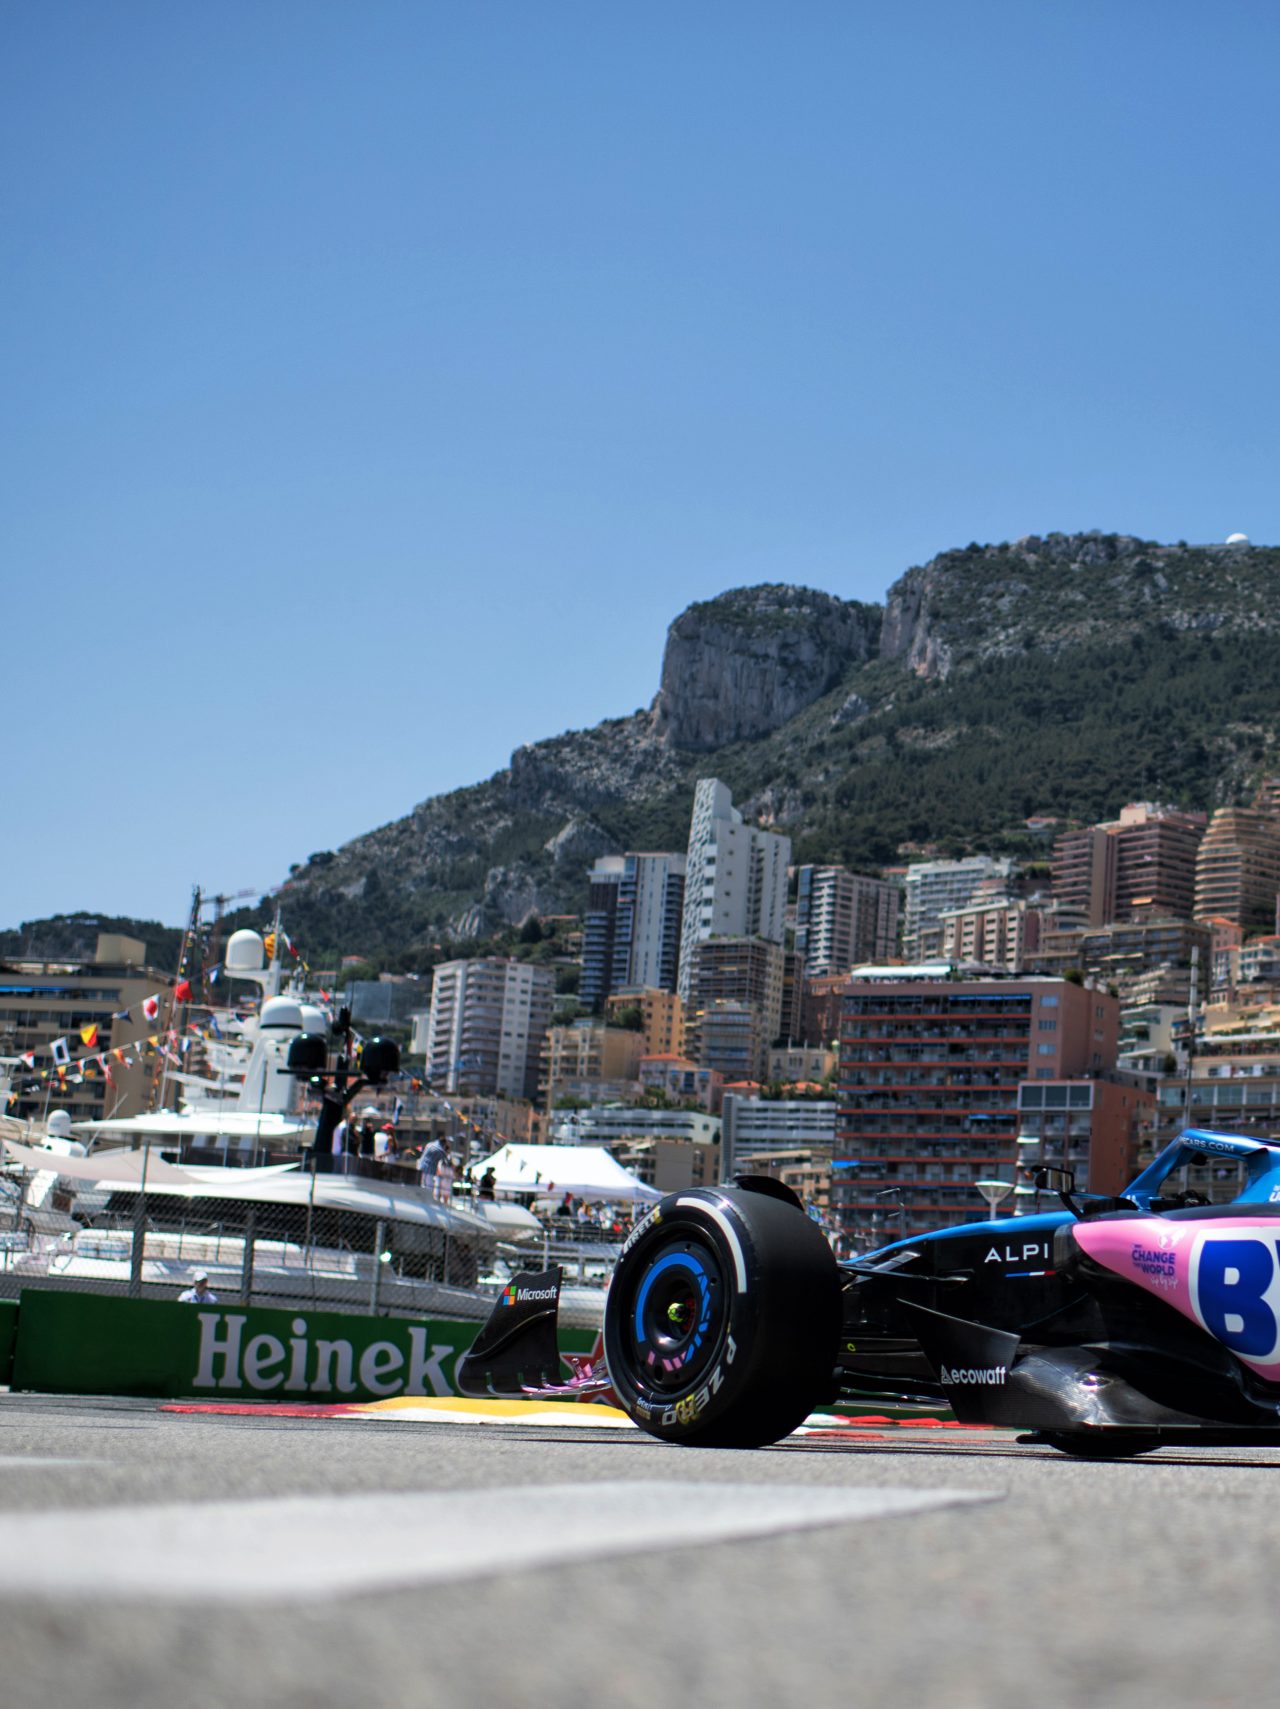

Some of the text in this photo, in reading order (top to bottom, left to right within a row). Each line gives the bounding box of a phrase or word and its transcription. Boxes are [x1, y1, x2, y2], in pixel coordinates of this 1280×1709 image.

[984, 1243, 1049, 1263] ALPI
[1132, 1249, 1176, 1264] CHANGE
[1142, 1263, 1175, 1276] WORLD
[517, 1285, 558, 1301] Microsoft
[193, 1313, 470, 1397] Heinek
[661, 1335, 737, 1426] P ZERO
